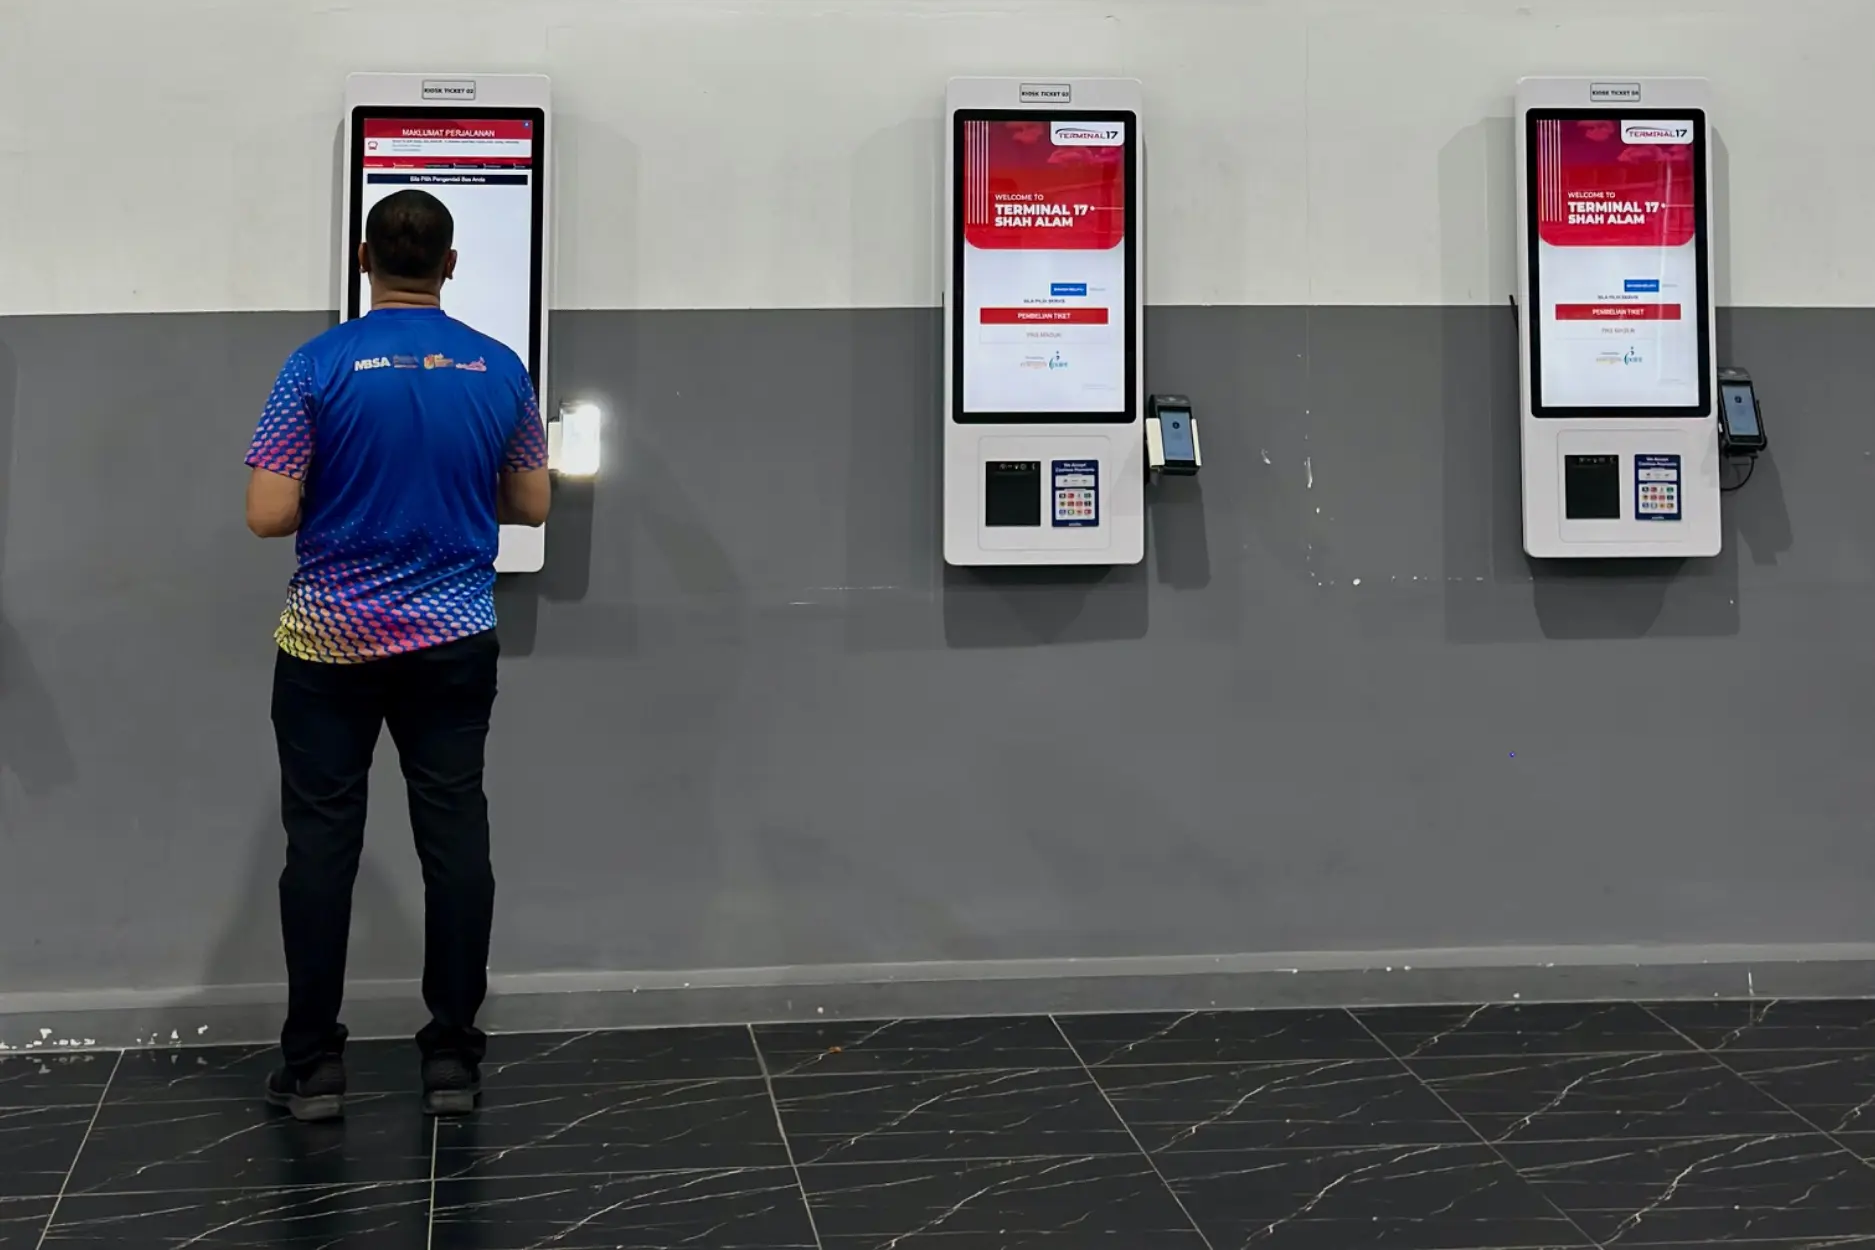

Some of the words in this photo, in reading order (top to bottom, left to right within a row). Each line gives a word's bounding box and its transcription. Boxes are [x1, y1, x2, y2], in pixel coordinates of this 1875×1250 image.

[402, 129, 444, 137] MAKLUMAT
[445, 129, 495, 138] PERJALANAN
[995, 204, 1070, 215] TERMINAL
[1073, 204, 1088, 215] 17
[1568, 202, 1642, 212] TERMINAL
[1645, 202, 1659, 212] 17
[995, 216, 1032, 227] SHAH
[1034, 216, 1073, 227] ALAM
[1568, 214, 1604, 224] SHAH
[1607, 214, 1645, 224] ALAM
[354, 356, 391, 371] MBSA
